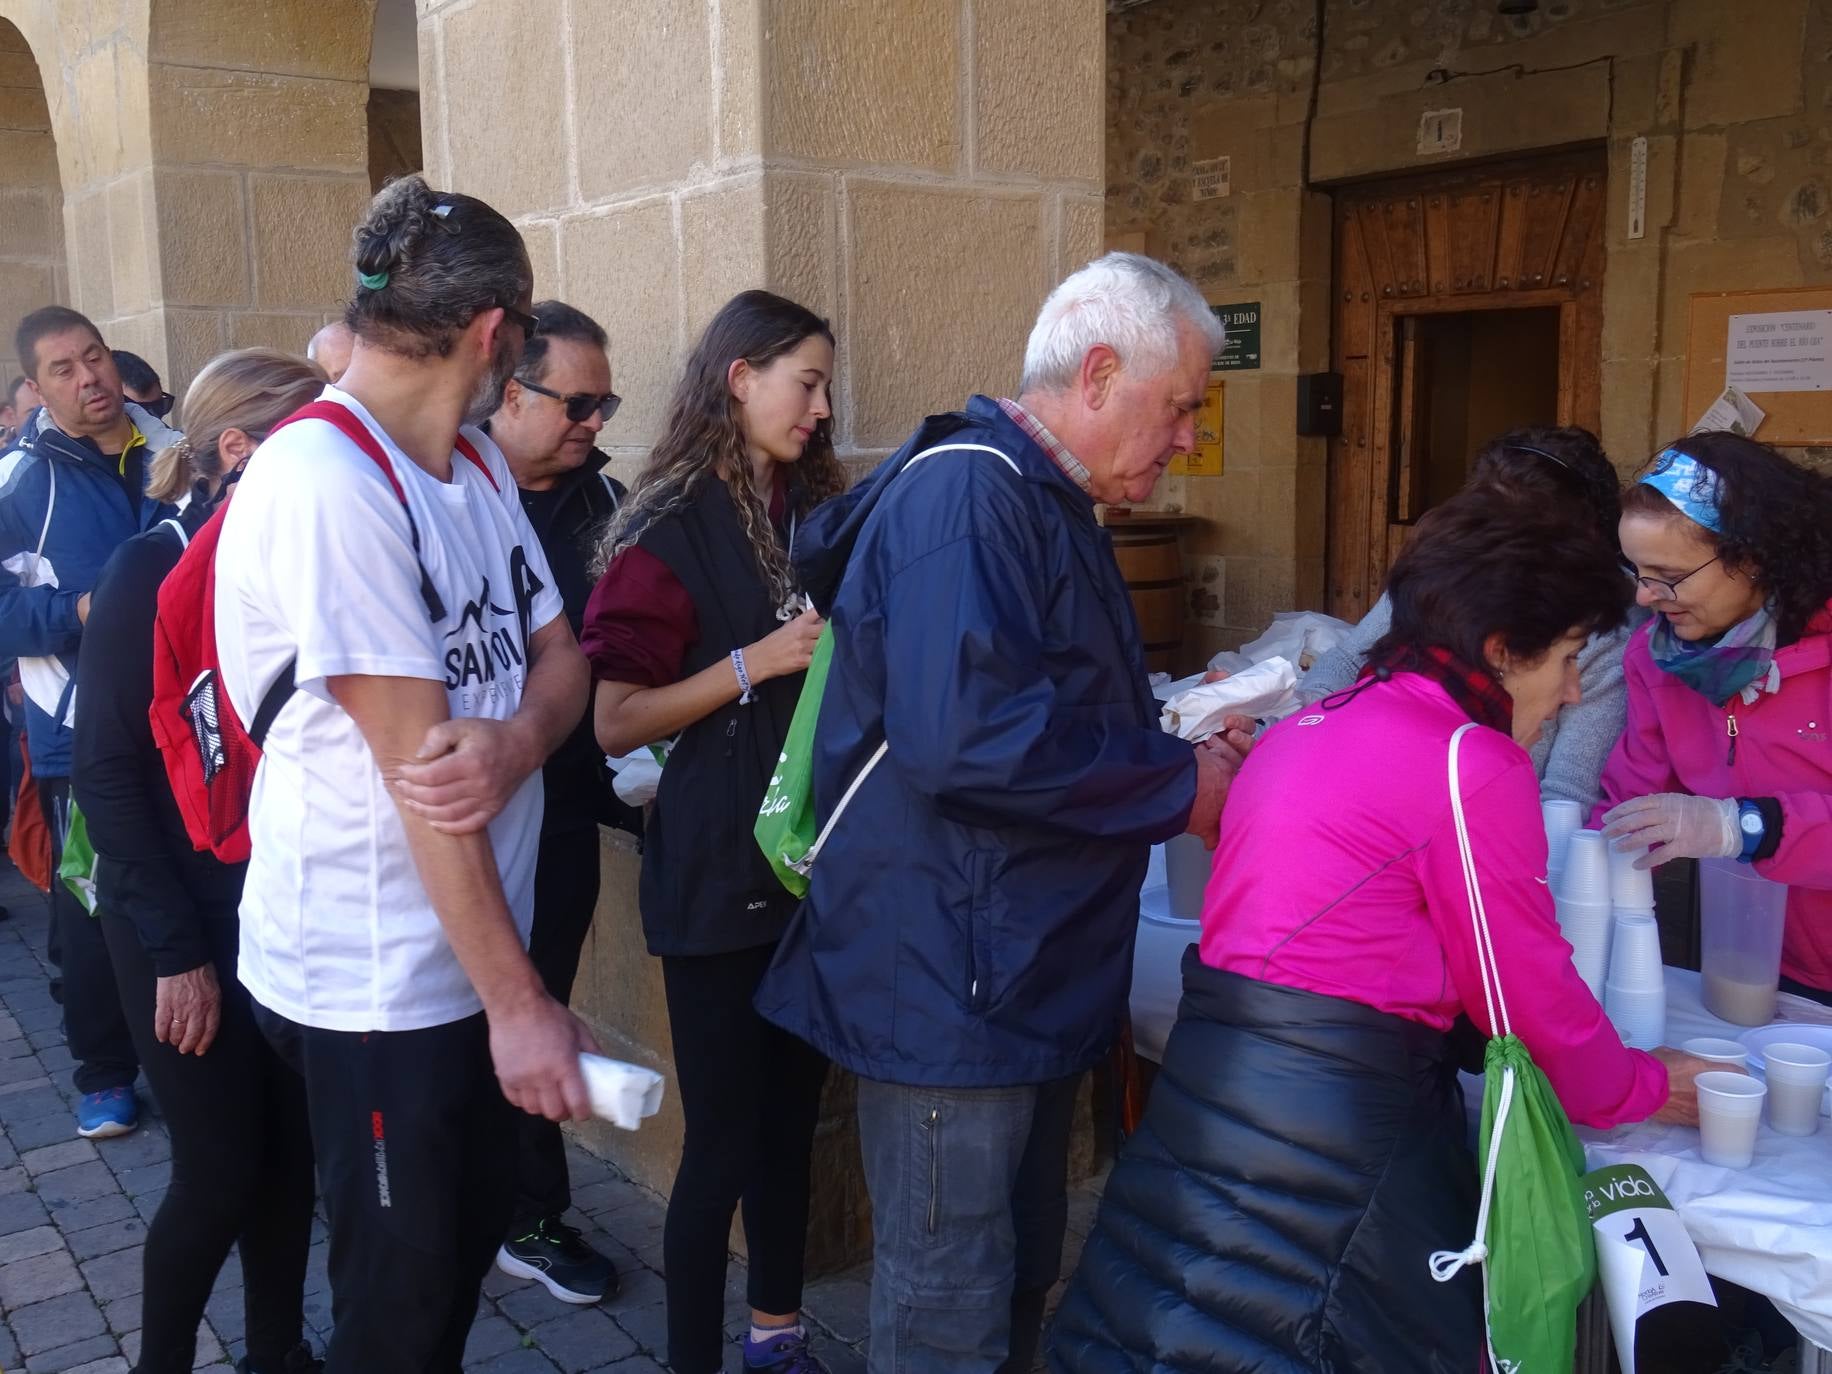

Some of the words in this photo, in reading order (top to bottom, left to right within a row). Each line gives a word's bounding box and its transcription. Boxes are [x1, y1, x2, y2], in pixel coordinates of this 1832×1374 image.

[1233, 312, 1257, 325] EDAD
[1599, 1175, 1656, 1201] vida
[1624, 1217, 1669, 1277] 1
